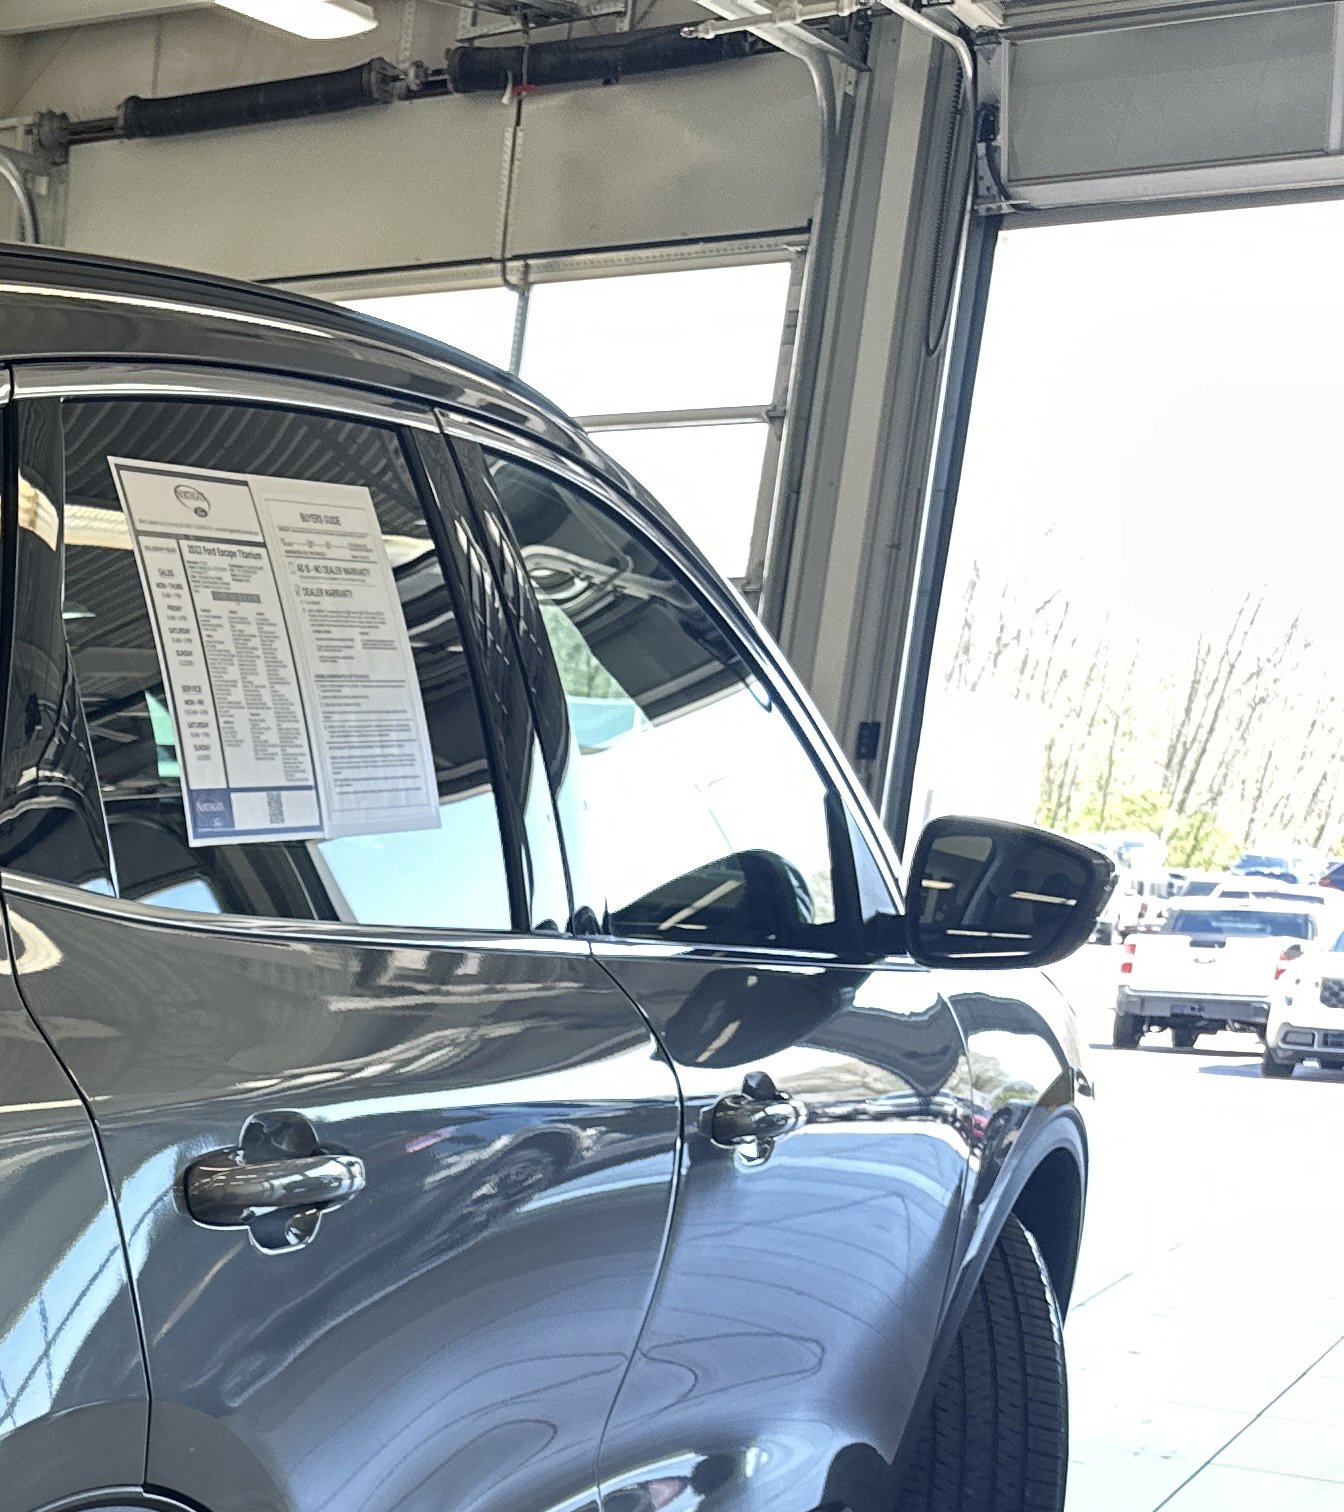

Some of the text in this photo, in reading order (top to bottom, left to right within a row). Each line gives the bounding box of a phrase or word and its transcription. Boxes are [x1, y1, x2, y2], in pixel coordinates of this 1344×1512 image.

[300, 512, 342, 526] BUYERS GUIDE
[187, 544, 202, 555] 2022
[203, 546, 217, 556] Ford
[217, 548, 237, 559] Escape
[236, 548, 263, 560] Titanium
[158, 568, 175, 577] SALES
[322, 566, 342, 576] DEALER
[343, 567, 370, 577] WARRANTY
[302, 586, 353, 598] DEALER WARRANTY
